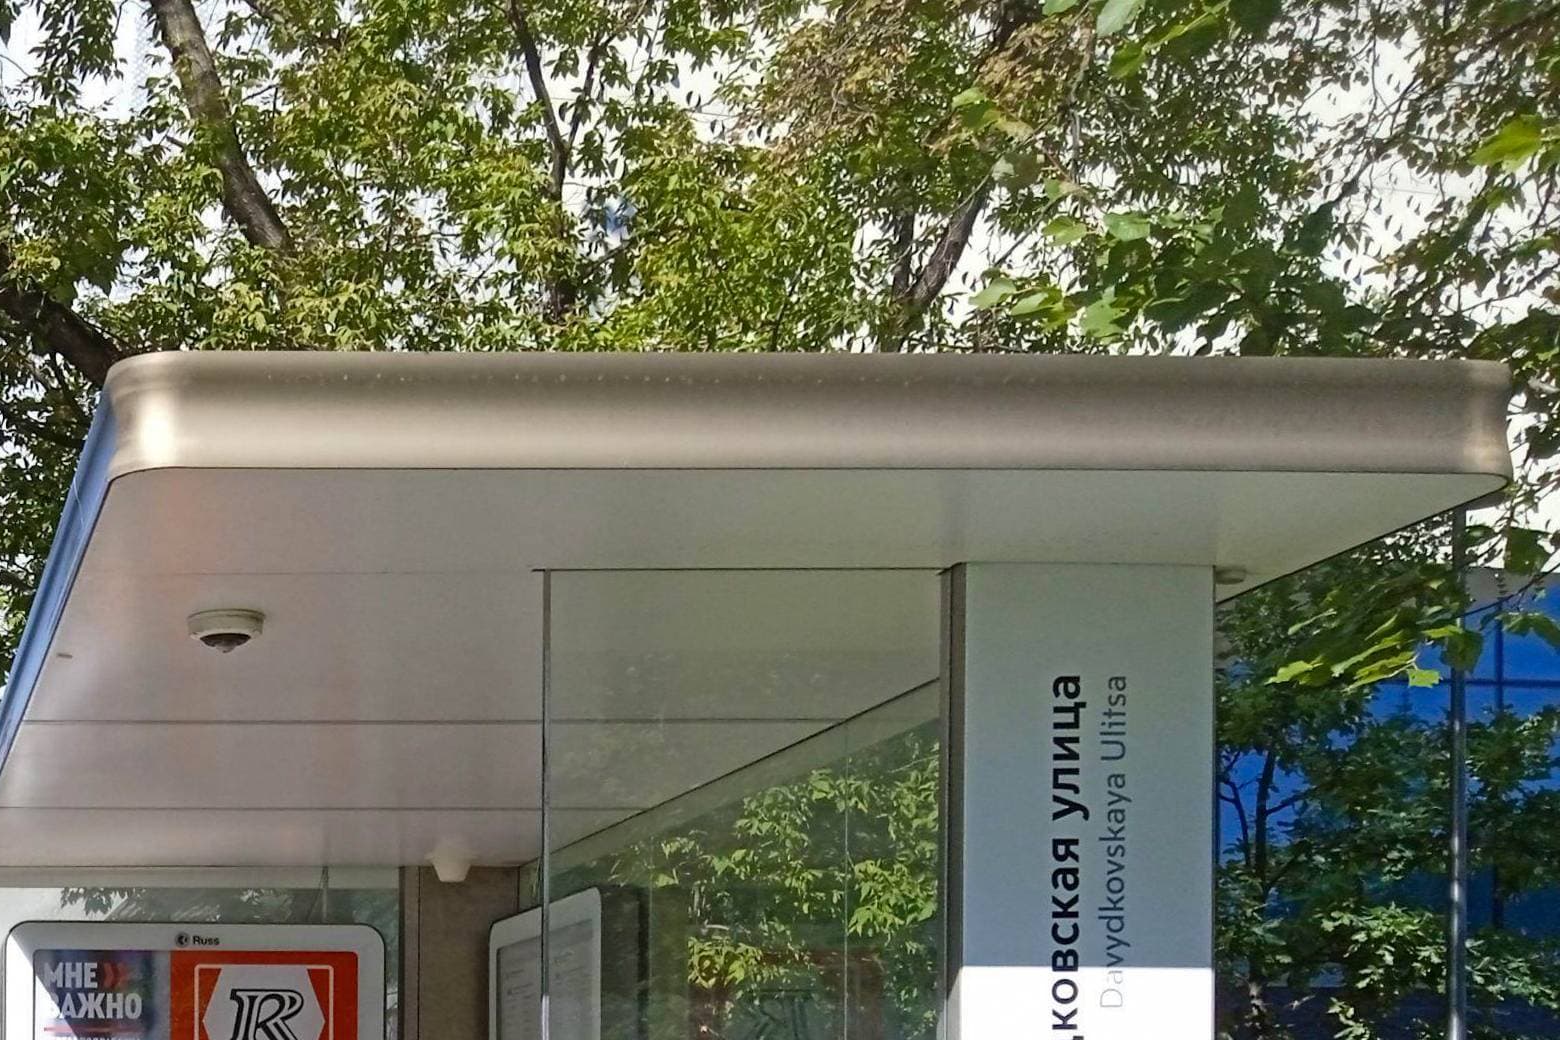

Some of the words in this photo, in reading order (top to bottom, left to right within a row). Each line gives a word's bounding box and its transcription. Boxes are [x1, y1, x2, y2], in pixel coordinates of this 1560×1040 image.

[1051, 674, 1091, 822] улица
[1099, 675, 1127, 761] Ulitsa
[1097, 772, 1133, 1008] Davydkovskaya
[44, 962, 98, 989] МНЕ
[192, 935, 220, 946] Russ
